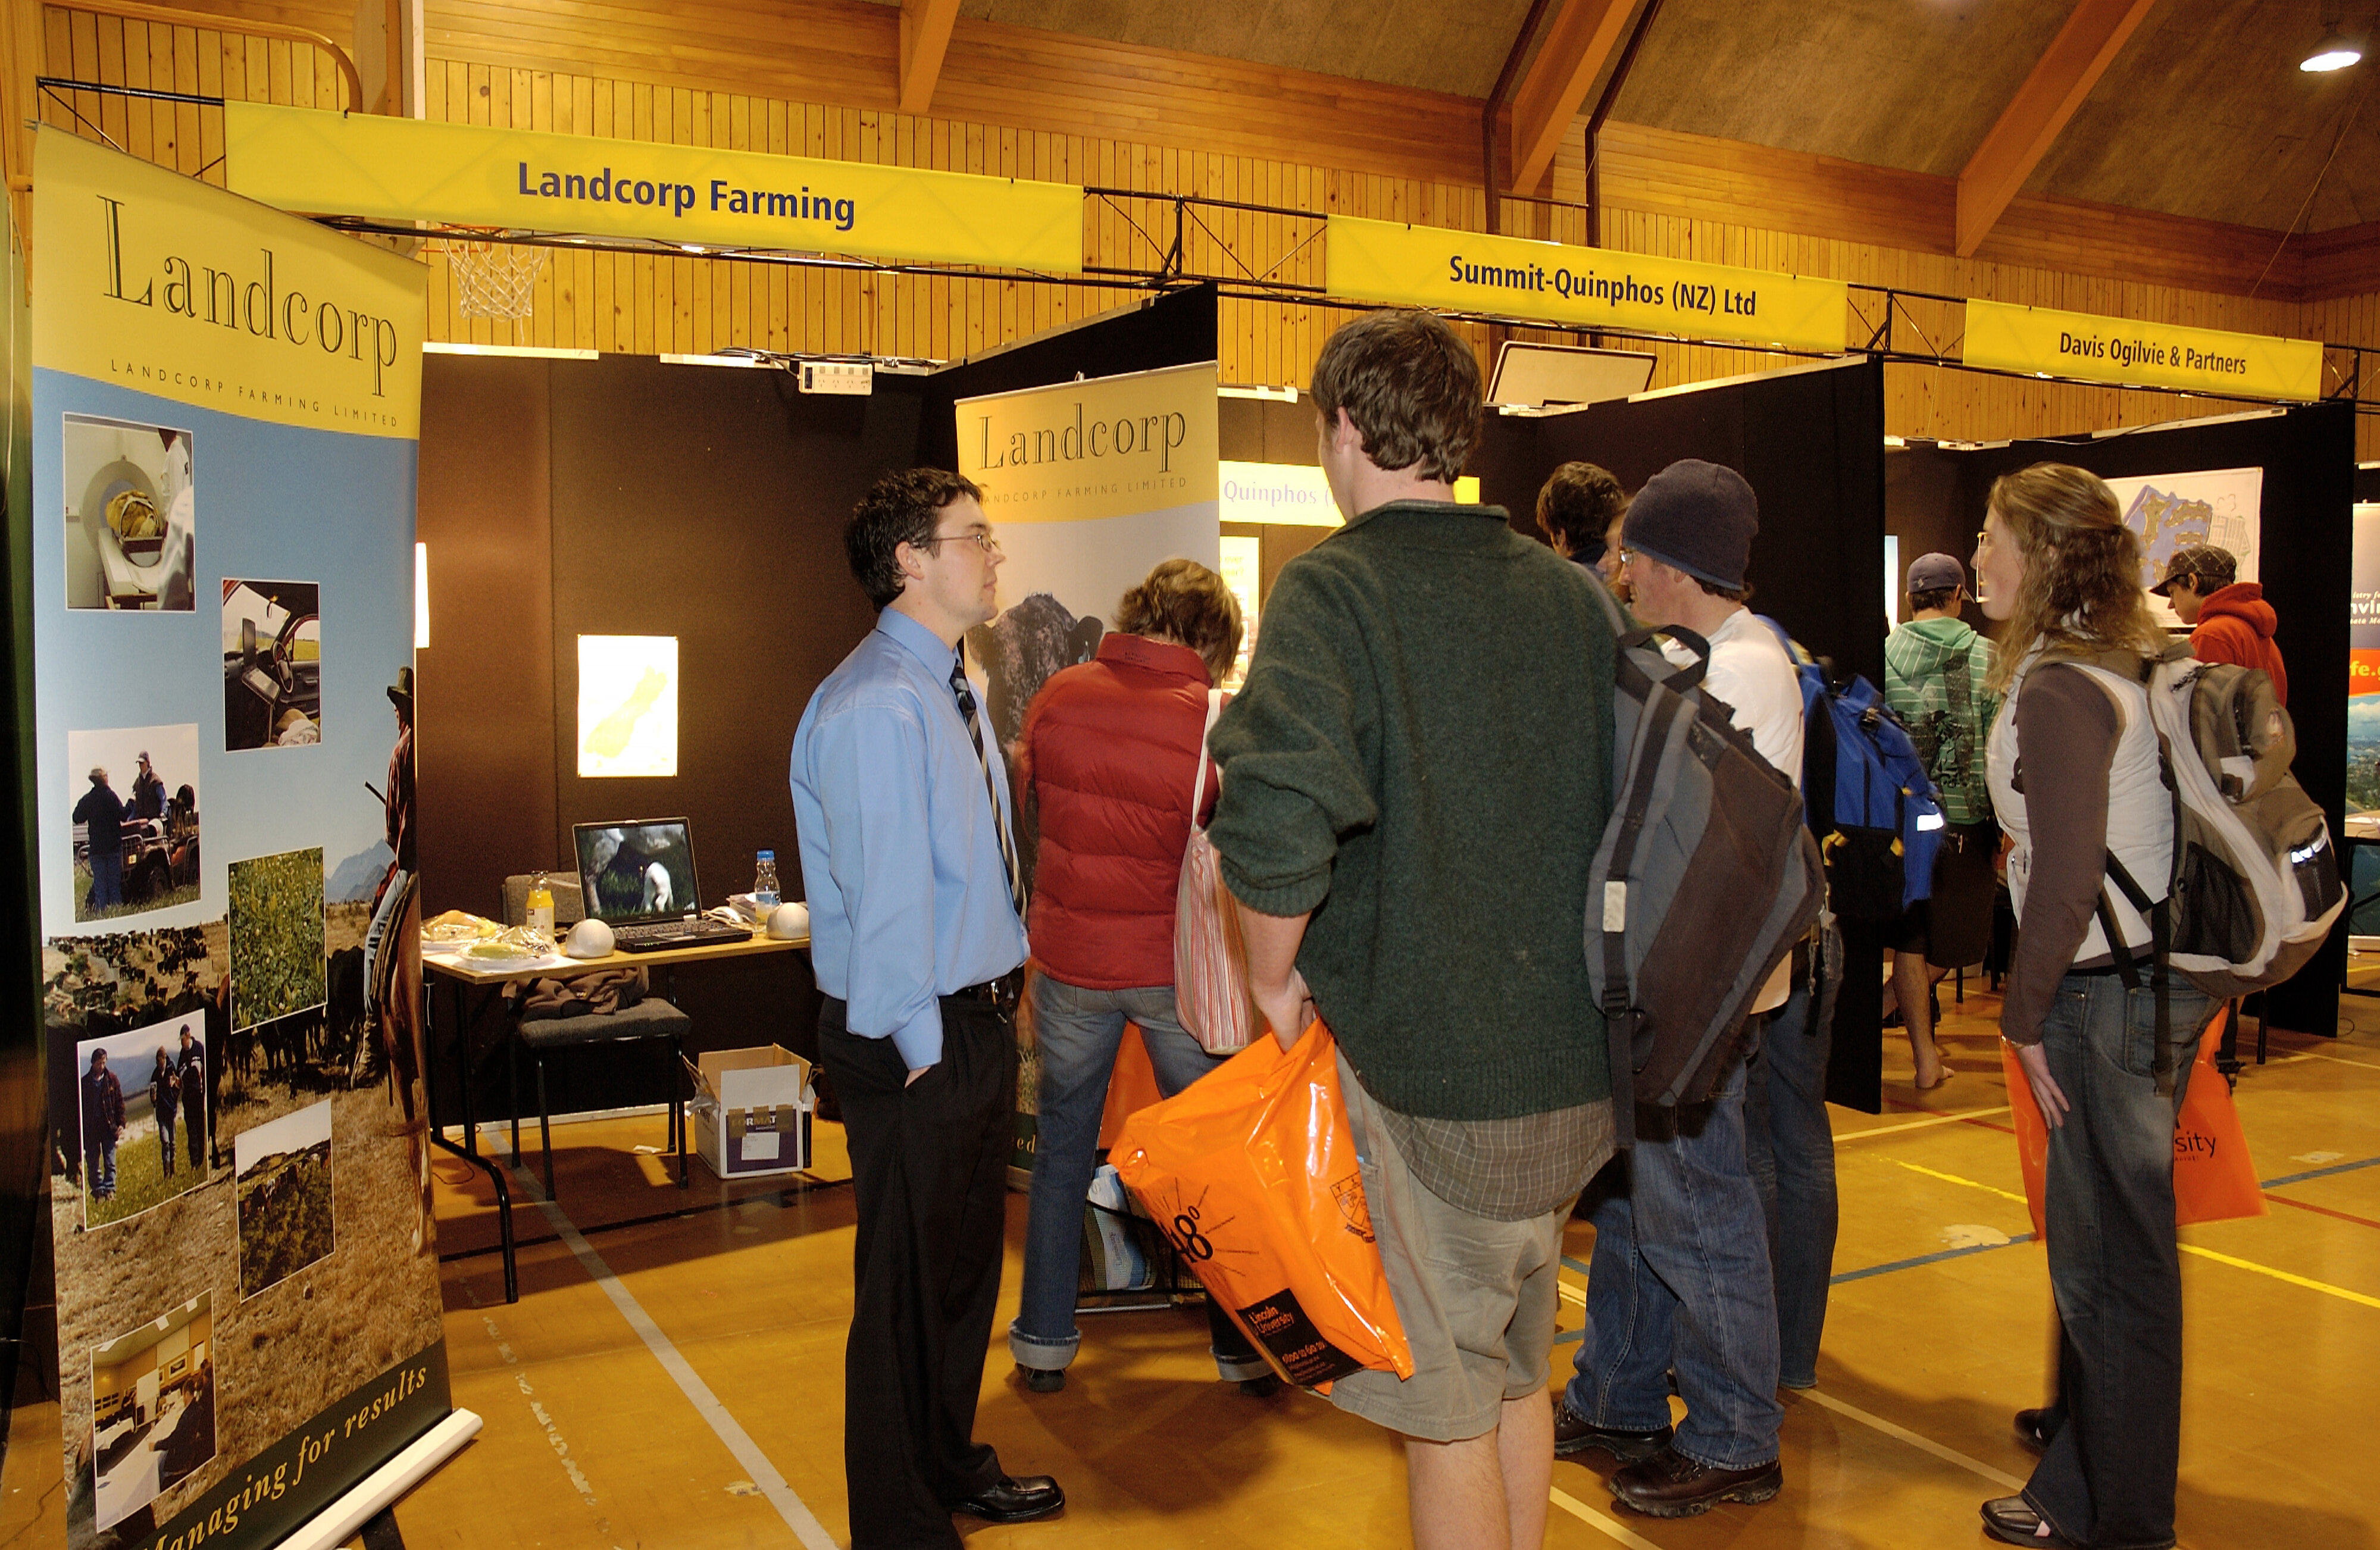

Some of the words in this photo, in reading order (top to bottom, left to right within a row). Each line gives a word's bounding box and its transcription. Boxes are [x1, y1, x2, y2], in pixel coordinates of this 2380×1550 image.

[519, 162, 695, 217] Landcorp
[711, 180, 855, 230] Farming
[96, 195, 397, 397] Landcorp
[1450, 256, 1664, 306] Summit-Quinphos
[1672, 281, 1716, 315] (NZ)
[1724, 289, 1756, 316] Ltd
[2060, 332, 2104, 358] Davis
[2110, 339, 2165, 367] Ogilvie
[2170, 346, 2181, 367] &
[2185, 347, 2246, 374] Partners
[111, 359, 224, 392] LANDCORP
[239, 386, 320, 412] FARMING
[334, 405, 398, 427] LIMITED
[978, 403, 1186, 472] Landcorp
[984, 490, 1047, 505] ANDCORP
[1057, 483, 1118, 498] FARMING
[1128, 477, 1187, 493] LIMITED
[1224, 481, 1316, 507] Quinphos
[1017, 1134, 1036, 1154] ed
[292, 1426, 336, 1486] for
[345, 1366, 427, 1439] results
